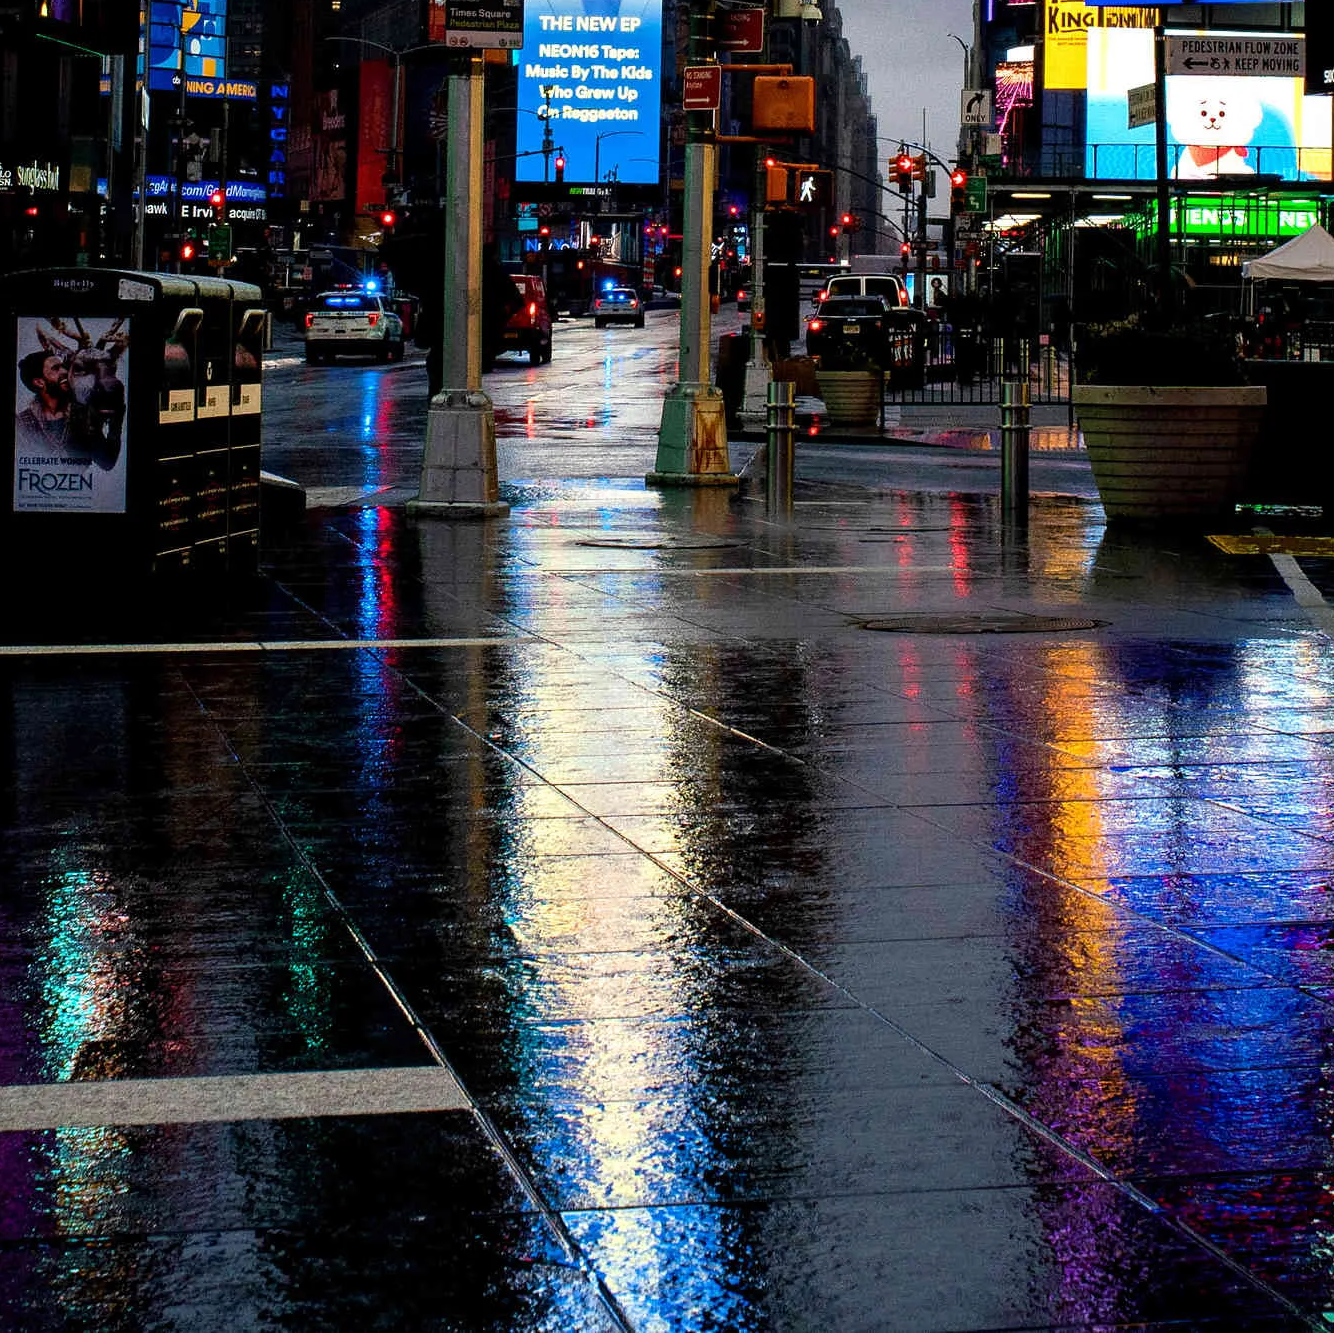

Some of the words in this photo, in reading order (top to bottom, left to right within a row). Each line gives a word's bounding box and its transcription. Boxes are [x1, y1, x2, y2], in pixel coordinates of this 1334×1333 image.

[450, 7, 478, 18] Times
[478, 8, 512, 19] Square
[1048, 6, 1095, 34] KING
[539, 16, 573, 32] THE
[576, 16, 618, 32] NEW
[620, 16, 642, 33] EP
[539, 44, 599, 60] NEON16
[601, 44, 640, 62] Tape:
[1182, 40, 1243, 54] PEDESTRIAN
[1245, 41, 1271, 55] FLOW
[1273, 41, 1300, 56] ZONE
[1234, 57, 1260, 71] KEEP
[1261, 58, 1300, 72] MOVING
[525, 65, 569, 80] Music
[571, 65, 590, 83] By
[591, 65, 619, 80] The
[620, 65, 653, 81] Kids
[539, 85, 573, 101] Who
[575, 85, 615, 101] Grew
[617, 86, 639, 104] Up
[964, 114, 986, 123] ONLY
[18, 468, 93, 495] FROZEN
